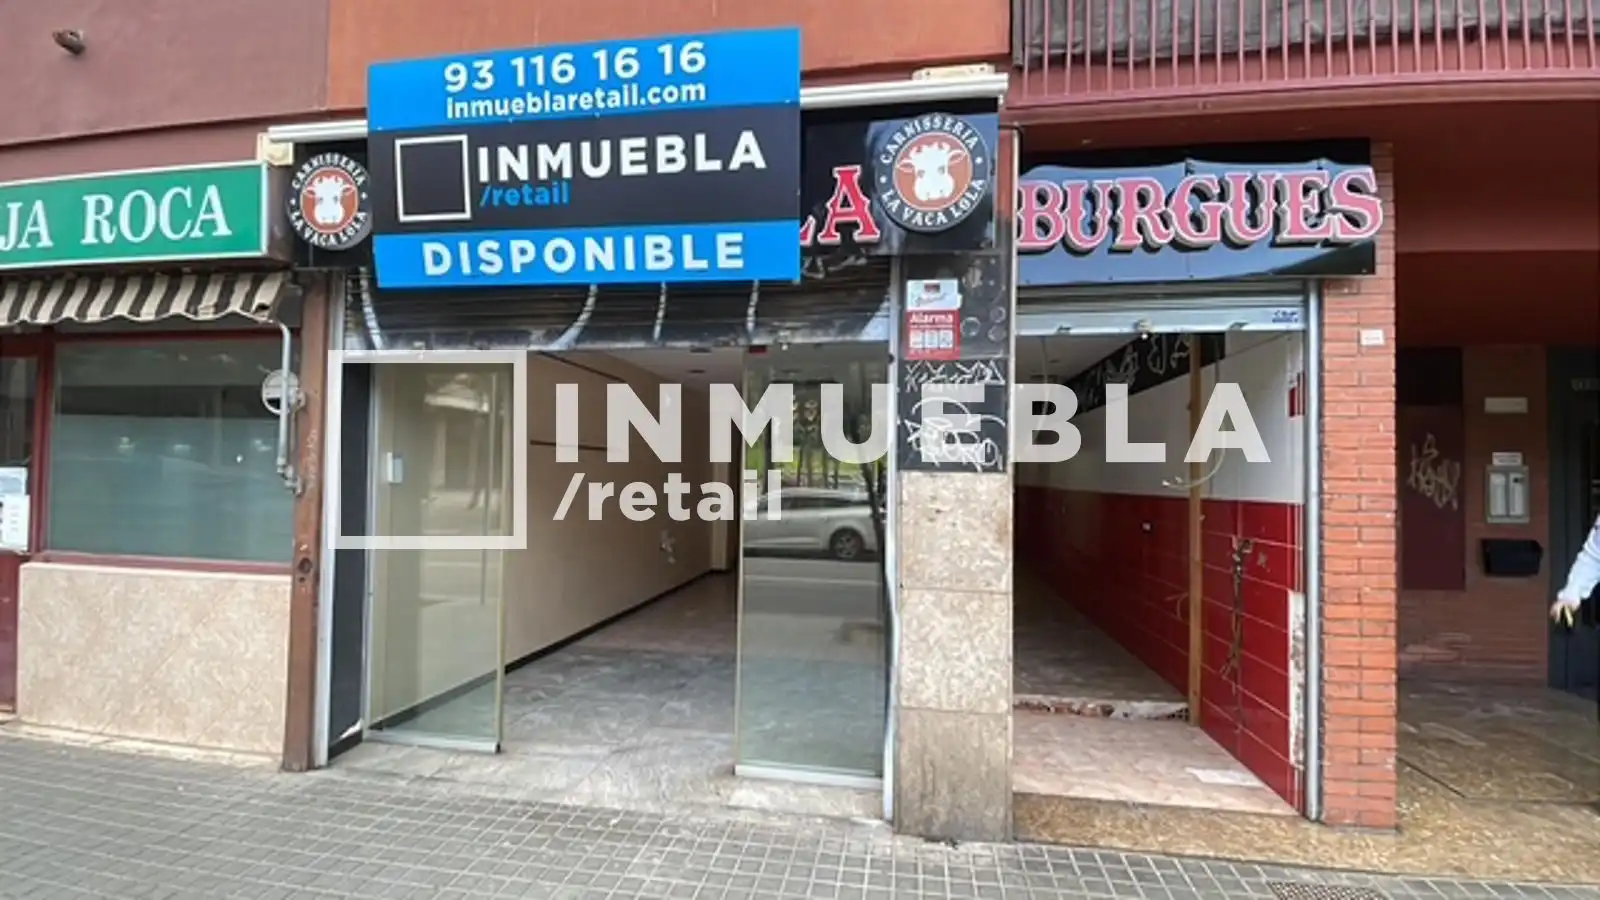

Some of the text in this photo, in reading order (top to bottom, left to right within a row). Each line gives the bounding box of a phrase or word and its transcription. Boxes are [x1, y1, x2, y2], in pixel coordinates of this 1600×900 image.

[444, 41, 706, 93] 93 116 16 16
[447, 82, 706, 119] inmueblaretail.com
[477, 130, 767, 183] INMUEBLA
[880, 116, 978, 164] CARNISSERIA
[80, 184, 232, 245] ROCA
[479, 181, 570, 208] /retail
[800, 165, 880, 245] A
[881, 179, 985, 226] LA VACA LOLA
[1017, 167, 1382, 250] BURGUES
[422, 232, 745, 277] DISPONIBLE
